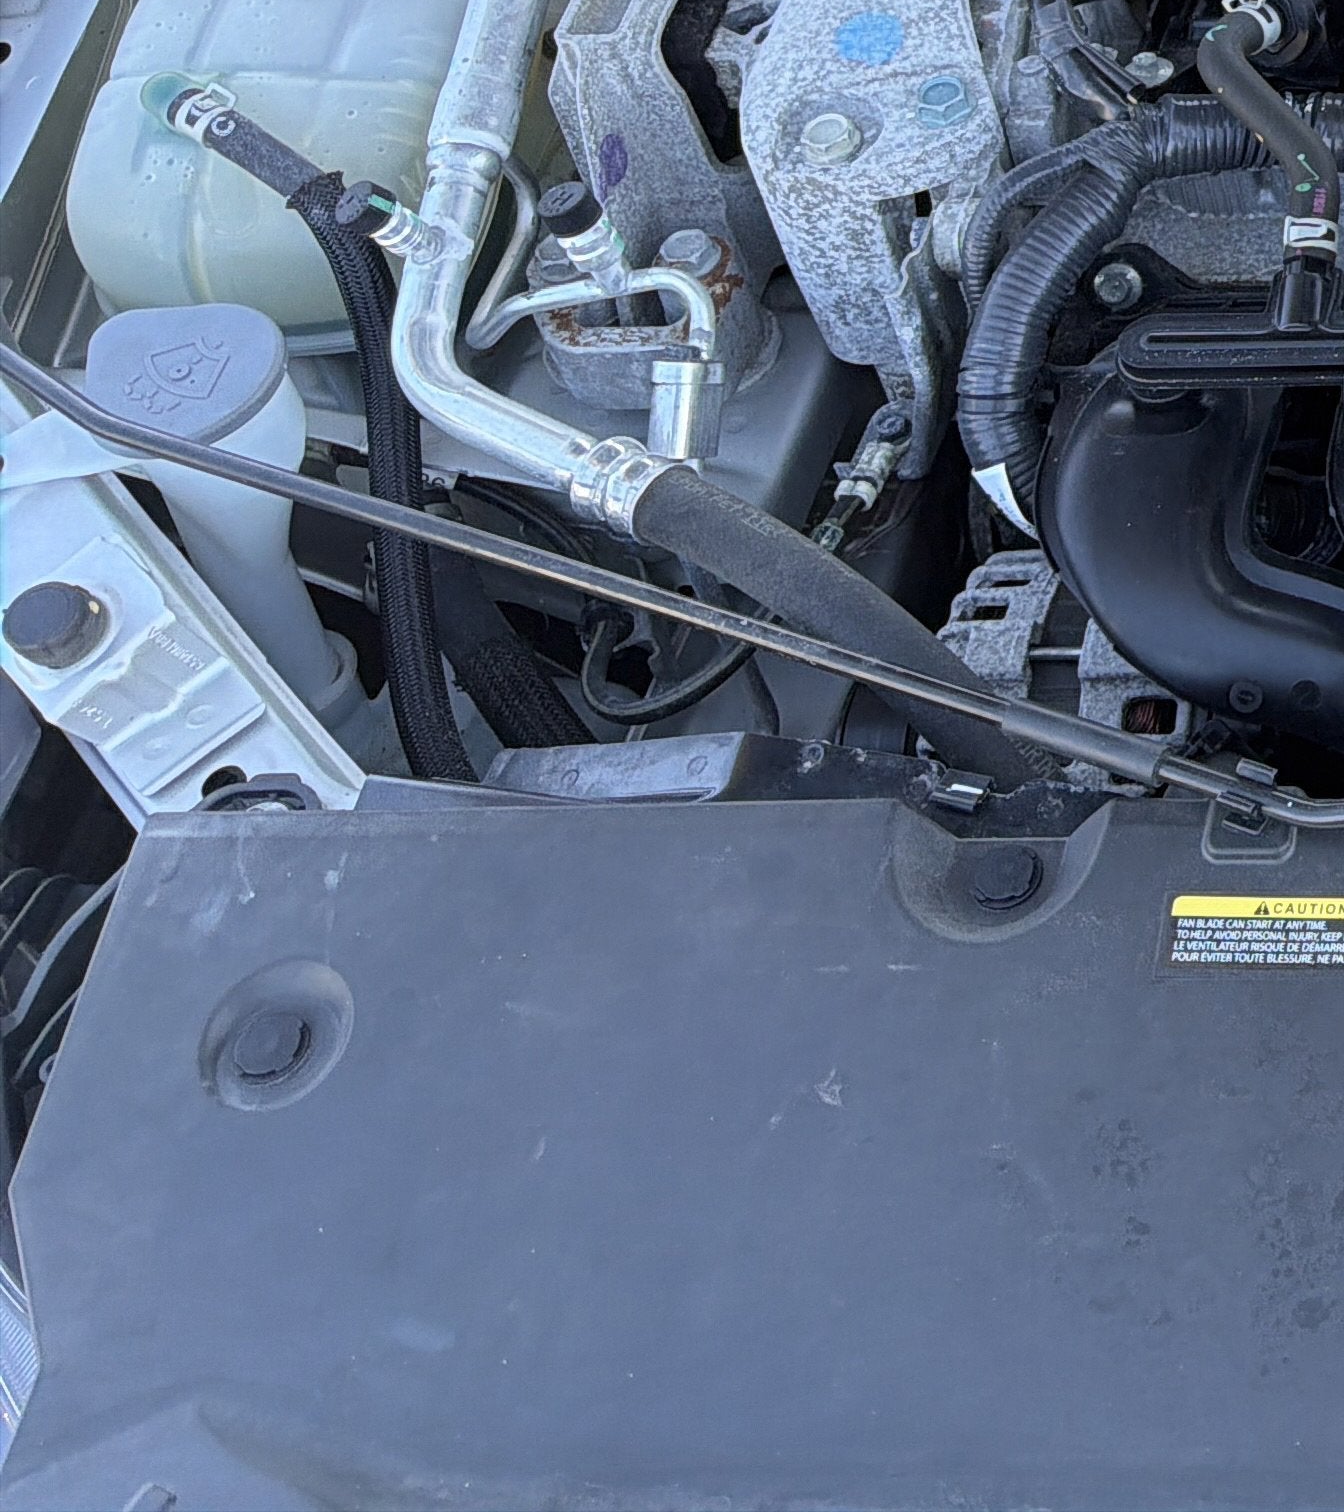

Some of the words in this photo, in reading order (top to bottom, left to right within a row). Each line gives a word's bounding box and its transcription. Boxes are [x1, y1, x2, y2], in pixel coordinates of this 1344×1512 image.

[1177, 918, 1196, 928] FAN
[1195, 919, 1225, 929] BLADE
[1225, 919, 1246, 929] CAN
[1246, 920, 1272, 930] START
[1273, 920, 1285, 930] AT
[1285, 920, 1307, 930] ANY
[1306, 921, 1329, 931] TIME.
[1177, 930, 1190, 940] TO
[1190, 930, 1213, 940] HELP
[1213, 930, 1242, 940] AVOID
[1242, 931, 1287, 941] PERSONAL
[1288, 931, 1320, 942] INJURY,
[1320, 932, 1343, 942] KEEP
[1173, 941, 1185, 951] LE
[1186, 941, 1250, 952] VENTILATEUR
[1250, 942, 1286, 952] RISQUE
[1286, 942, 1300, 952] DE
[1171, 952, 1200, 962] POUR
[1200, 950, 1234, 963] ÉVITER
[1233, 953, 1265, 963] TOUTE
[1266, 953, 1316, 965] BLESSURE,
[1316, 954, 1331, 964] NE
